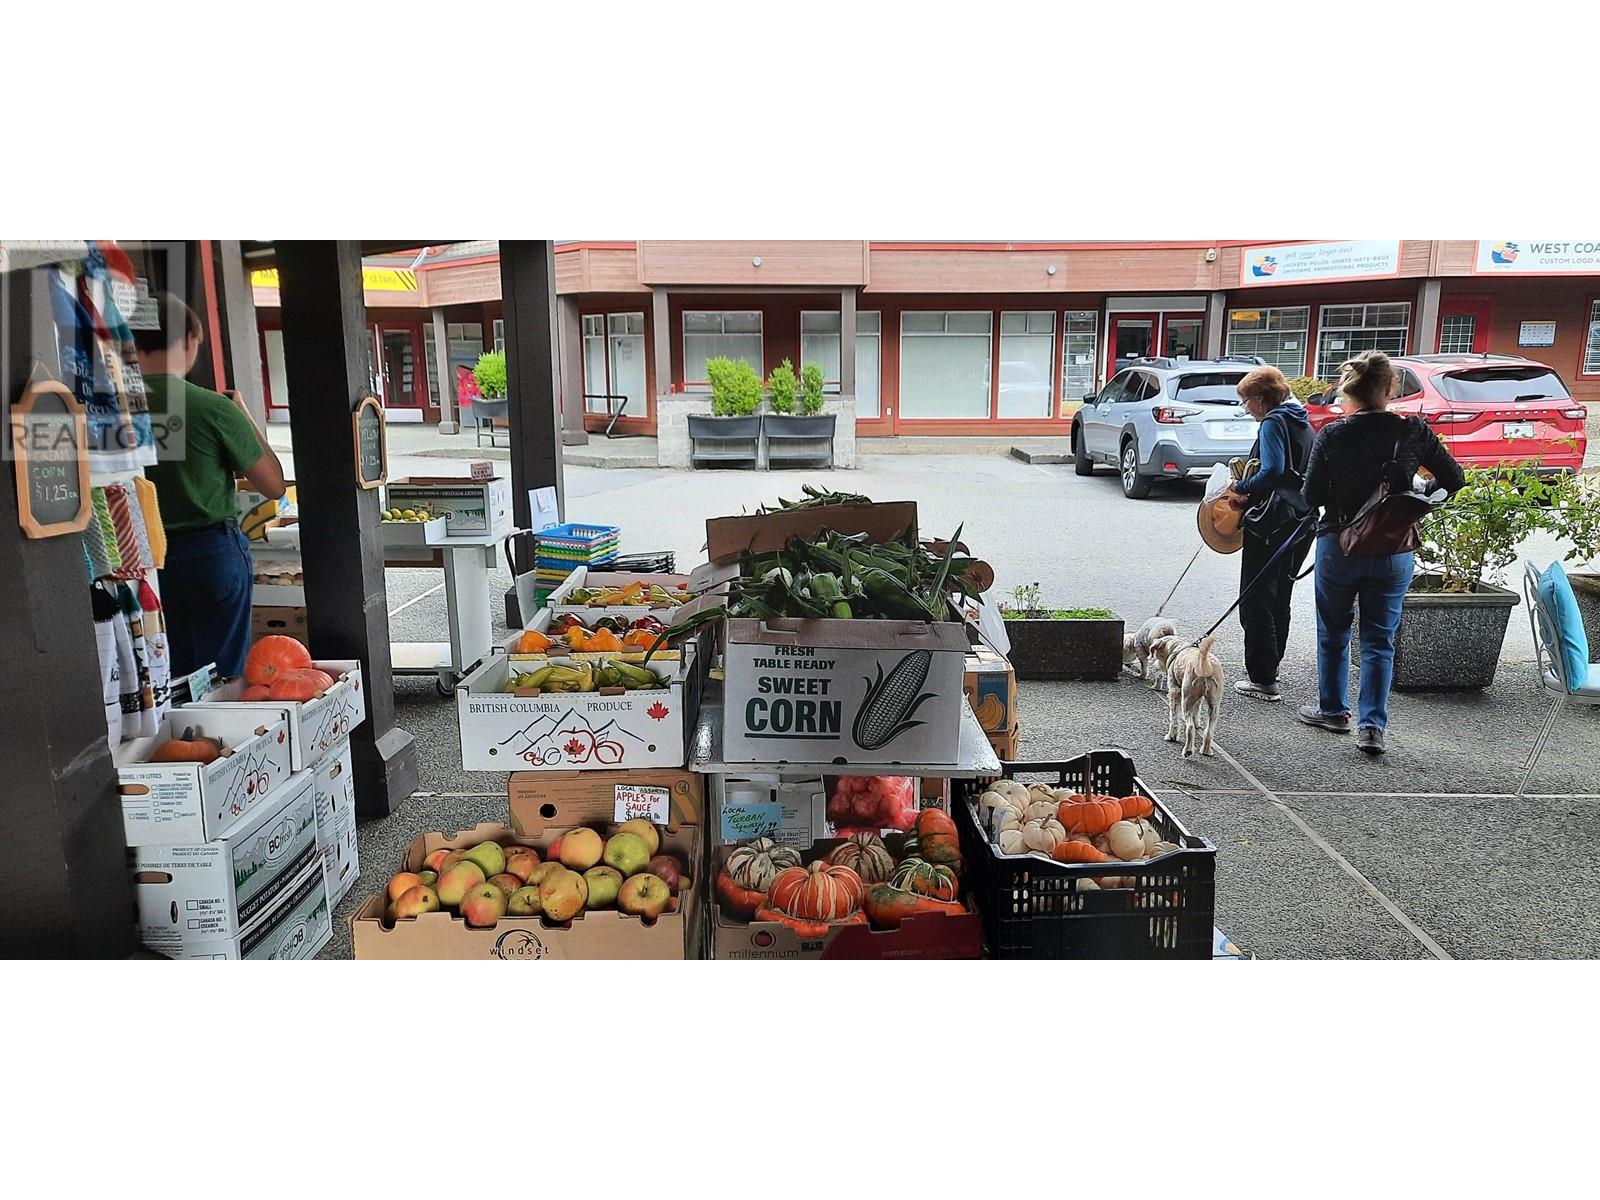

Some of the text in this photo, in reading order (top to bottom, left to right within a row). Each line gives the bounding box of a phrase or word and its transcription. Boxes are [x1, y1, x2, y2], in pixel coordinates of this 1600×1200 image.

[1530, 243, 1570, 254] WEST
[1356, 262, 1390, 270] PRODUCTS
[32, 467, 66, 480] CORN
[35, 481, 68, 502] $1.25
[774, 646, 815, 656] FRESH
[753, 658, 836, 670] TABLE READY
[758, 676, 832, 695] SWEET
[469, 701, 633, 713] BRITISH COLUMBIA PRODUCE
[745, 697, 842, 733] CORN
[208, 768, 226, 785] BRITISH
[225, 754, 247, 773] COLUMBIA
[616, 792, 646, 802] APPLES
[625, 803, 652, 811] SAUCE
[728, 812, 766, 823] TURBAN
[489, 946, 549, 955] windset
[729, 949, 798, 959] millennium
